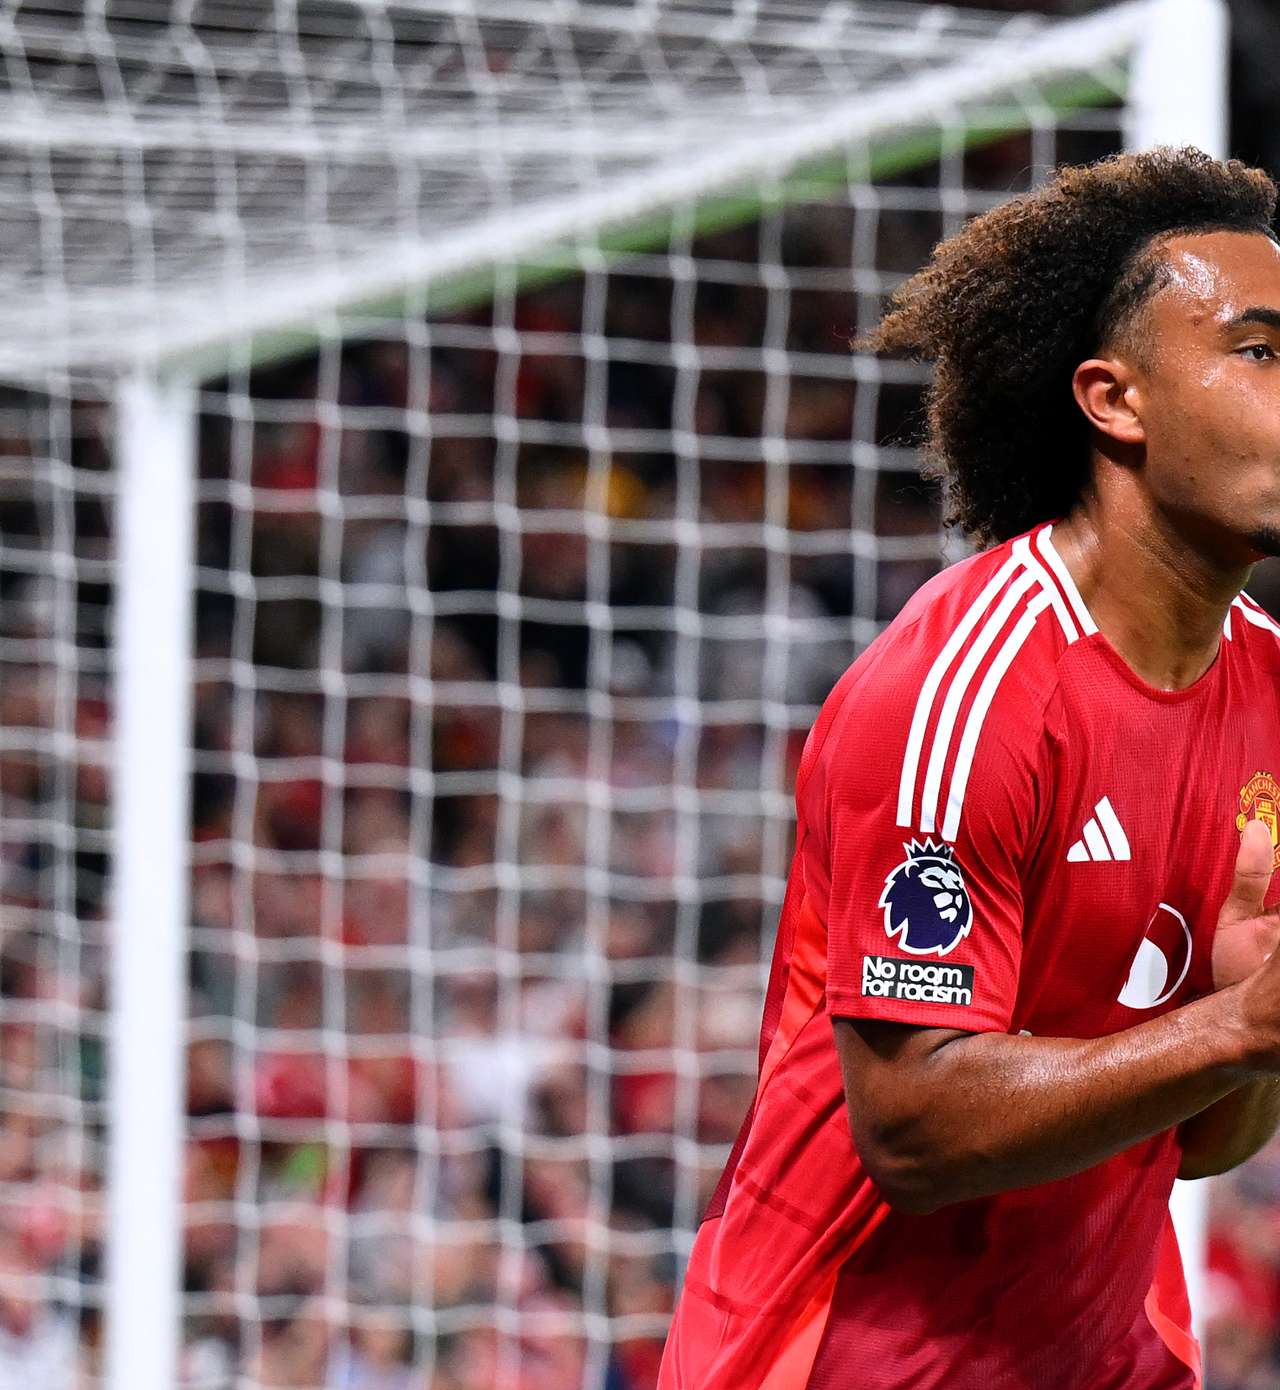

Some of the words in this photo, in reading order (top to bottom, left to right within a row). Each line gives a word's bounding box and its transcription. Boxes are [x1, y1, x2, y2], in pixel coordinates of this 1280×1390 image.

[863, 956, 896, 979] No
[899, 963, 963, 986] room
[896, 982, 971, 1005] racism
